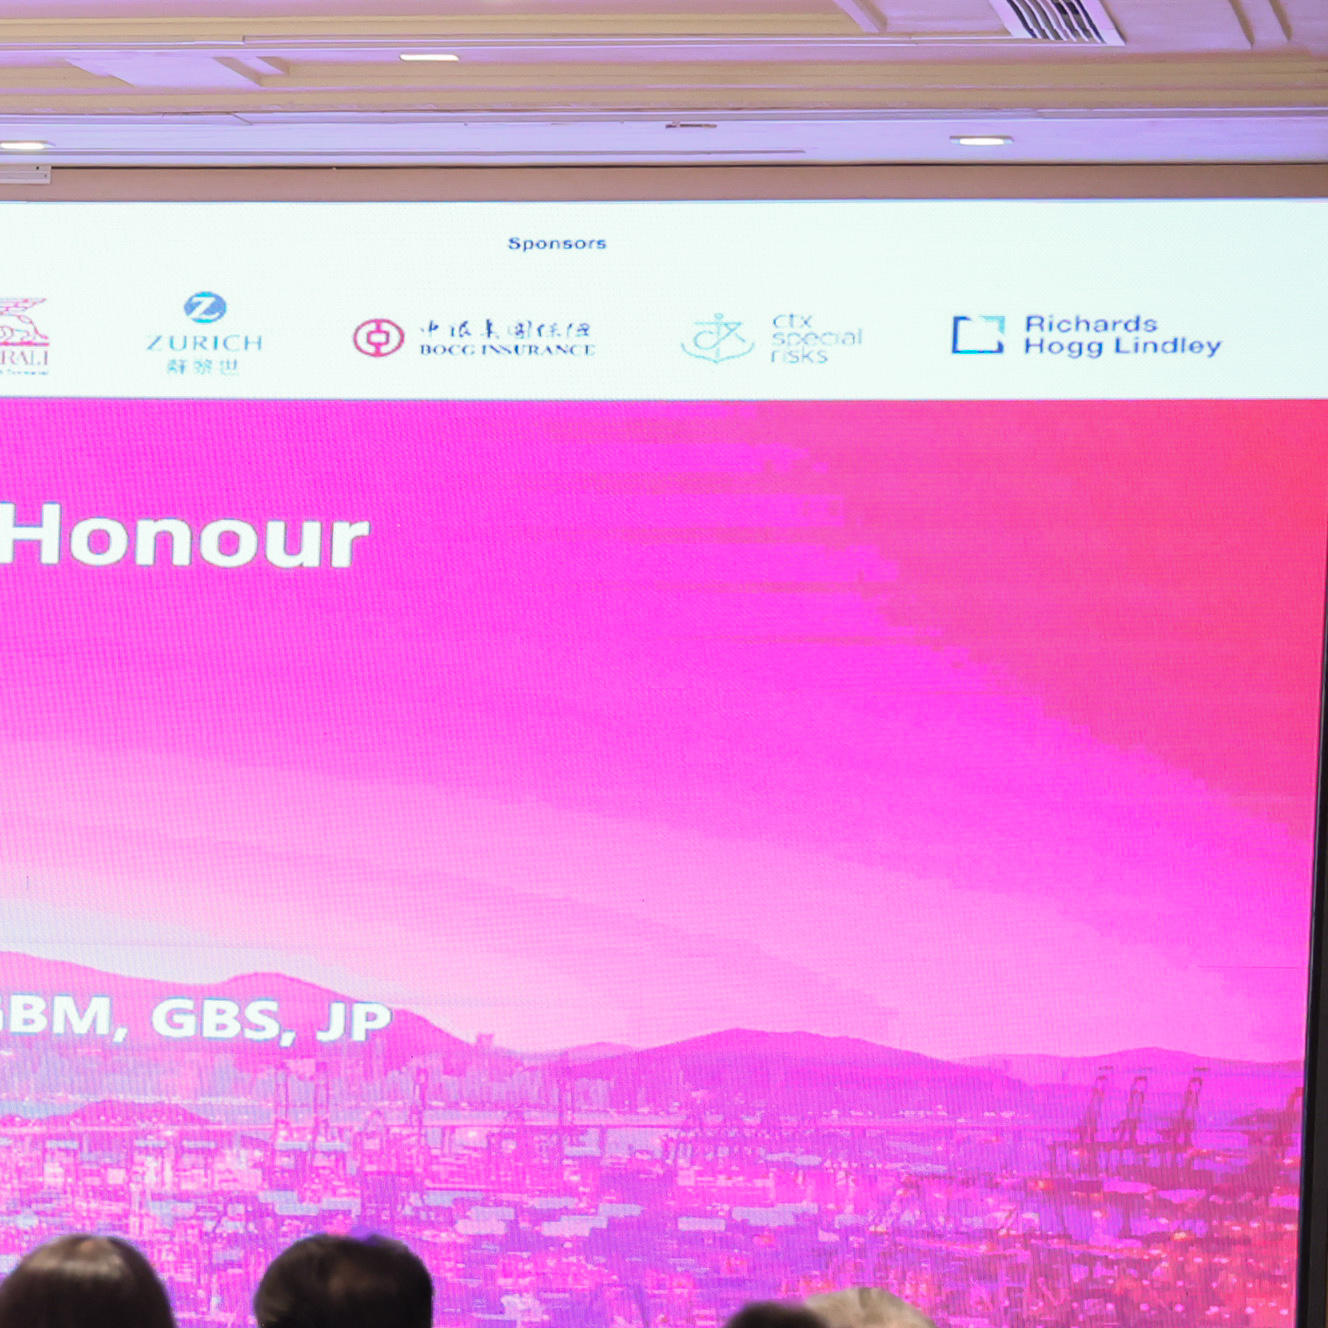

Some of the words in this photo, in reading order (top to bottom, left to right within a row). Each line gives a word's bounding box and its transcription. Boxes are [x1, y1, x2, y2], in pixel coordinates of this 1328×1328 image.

[507, 236, 608, 252] Sponsors
[1025, 314, 1159, 333] Richards
[146, 335, 262, 351] ZURICH
[420, 344, 476, 356] BOCG
[481, 344, 596, 356] INSURANCE
[1025, 337, 1104, 359] Hogg
[1114, 336, 1223, 358] Lindley
[771, 346, 829, 364] risks
[150, 996, 297, 1049] GBS,
[316, 1001, 392, 1044] JP
